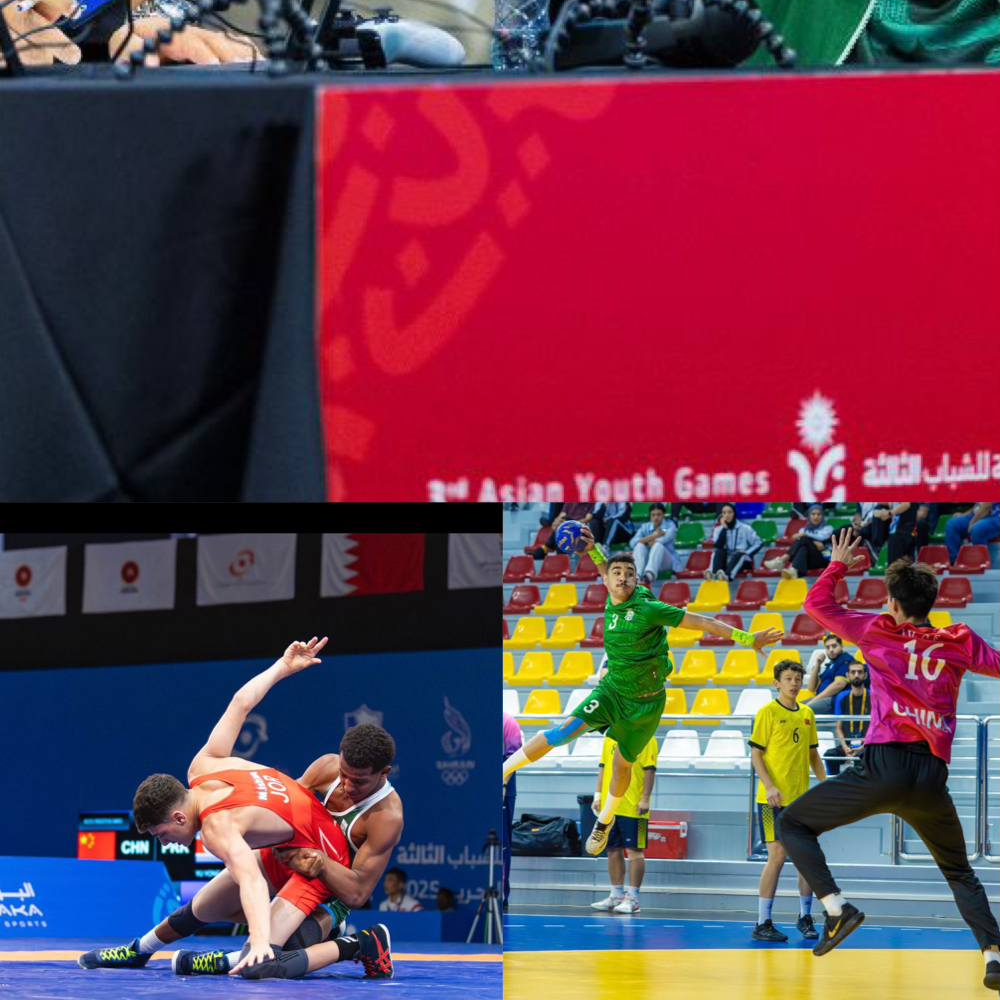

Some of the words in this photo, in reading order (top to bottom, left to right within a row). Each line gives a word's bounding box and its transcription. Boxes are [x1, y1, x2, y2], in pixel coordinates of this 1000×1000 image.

[478, 473, 565, 502] Asian
[573, 466, 665, 502] Youth
[672, 465, 771, 500] Games
[862, 451, 922, 487] الثالثة
[922, 450, 991, 492] للشباب
[608, 613, 618, 630] 3
[903, 638, 946, 681] 16
[582, 698, 600, 714] 3
[792, 726, 800, 744] 6
[266, 774, 290, 805] JOR
[120, 840, 150, 855] CHN
